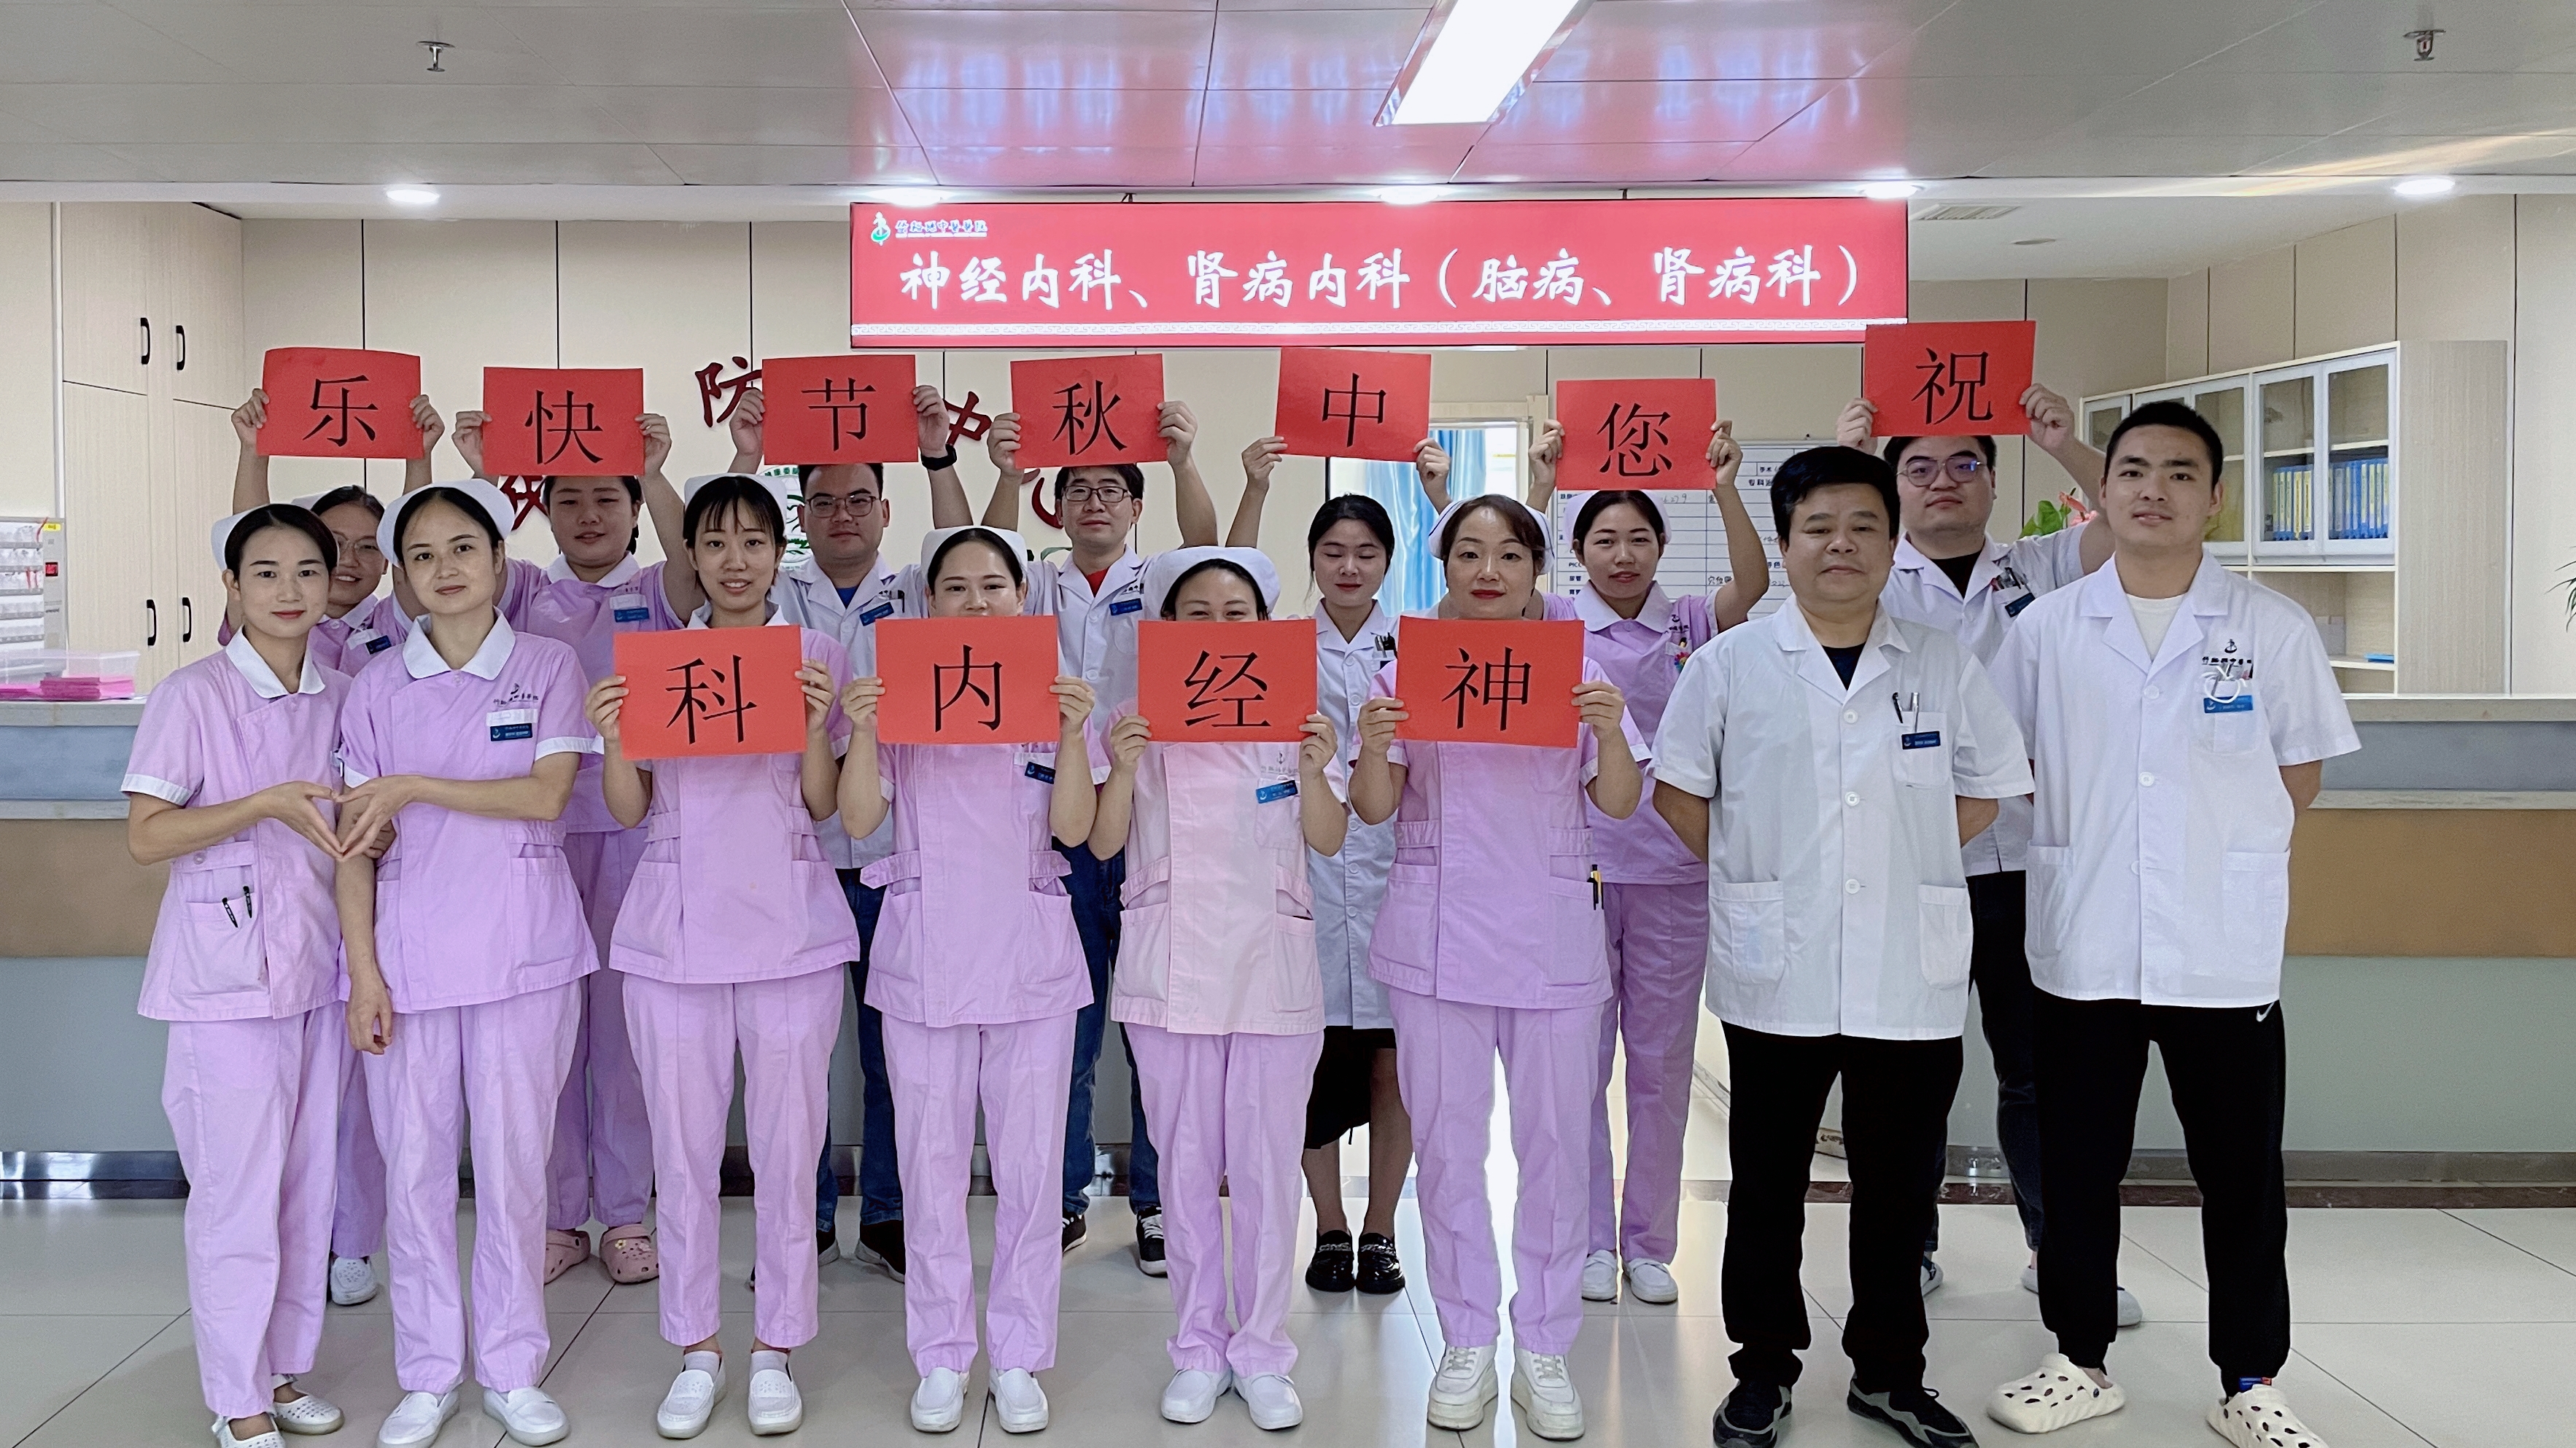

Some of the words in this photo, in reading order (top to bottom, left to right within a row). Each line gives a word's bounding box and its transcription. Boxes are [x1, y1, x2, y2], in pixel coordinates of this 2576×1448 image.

[303, 375, 379, 447] 乐
[802, 378, 875, 451] 节
[1052, 380, 1127, 456] 秋
[1322, 373, 1386, 448] 中
[1911, 348, 1994, 425] 祝
[525, 390, 603, 464] 快
[1597, 402, 1673, 477] 您
[664, 655, 757, 744] 科
[934, 645, 1002, 733] 内
[1184, 650, 1270, 728] 经
[1443, 647, 1532, 731] 神
